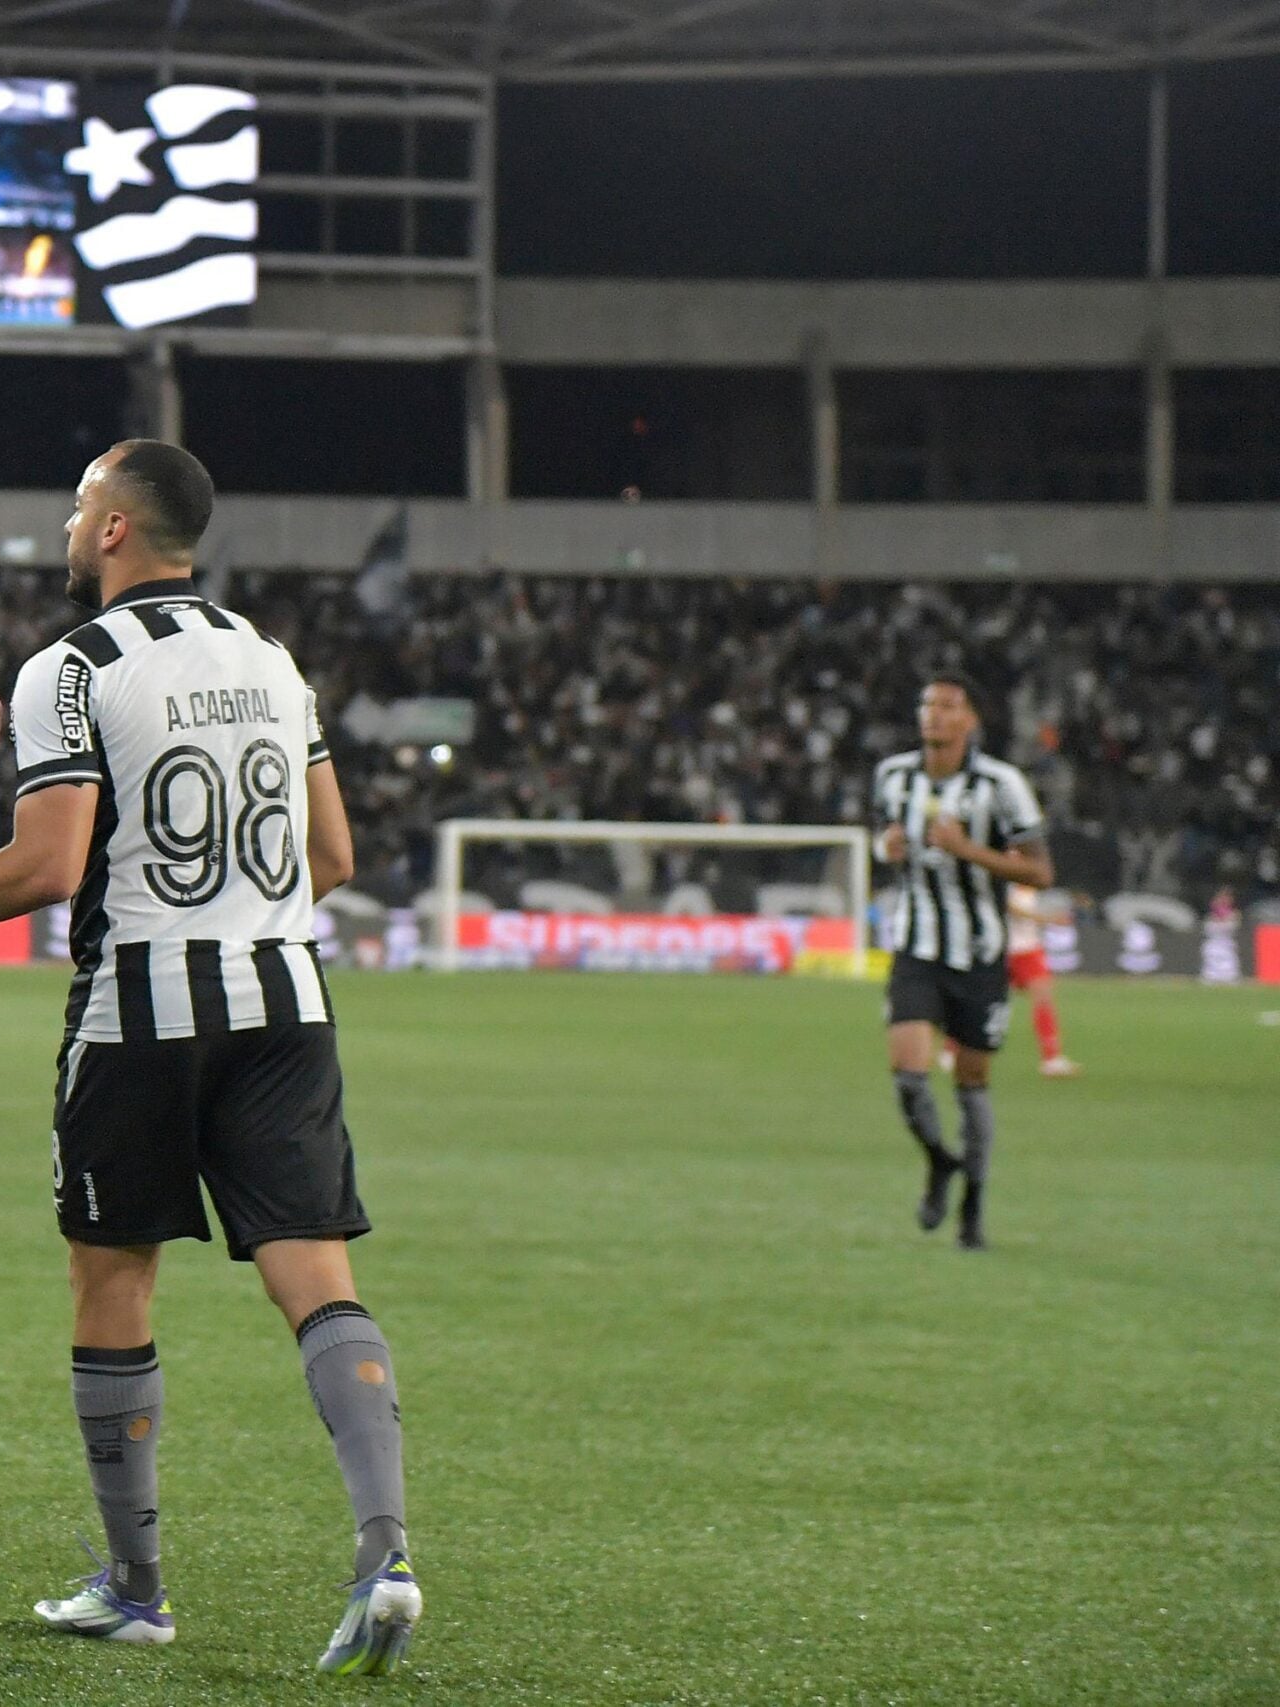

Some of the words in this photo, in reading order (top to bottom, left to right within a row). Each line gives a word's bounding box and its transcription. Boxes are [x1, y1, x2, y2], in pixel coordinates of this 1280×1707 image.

[56, 663, 85, 753] Centrum
[166, 688, 280, 732] A.CABRAL
[143, 738, 300, 907] 98
[82, 1171, 100, 1222] Reebok
